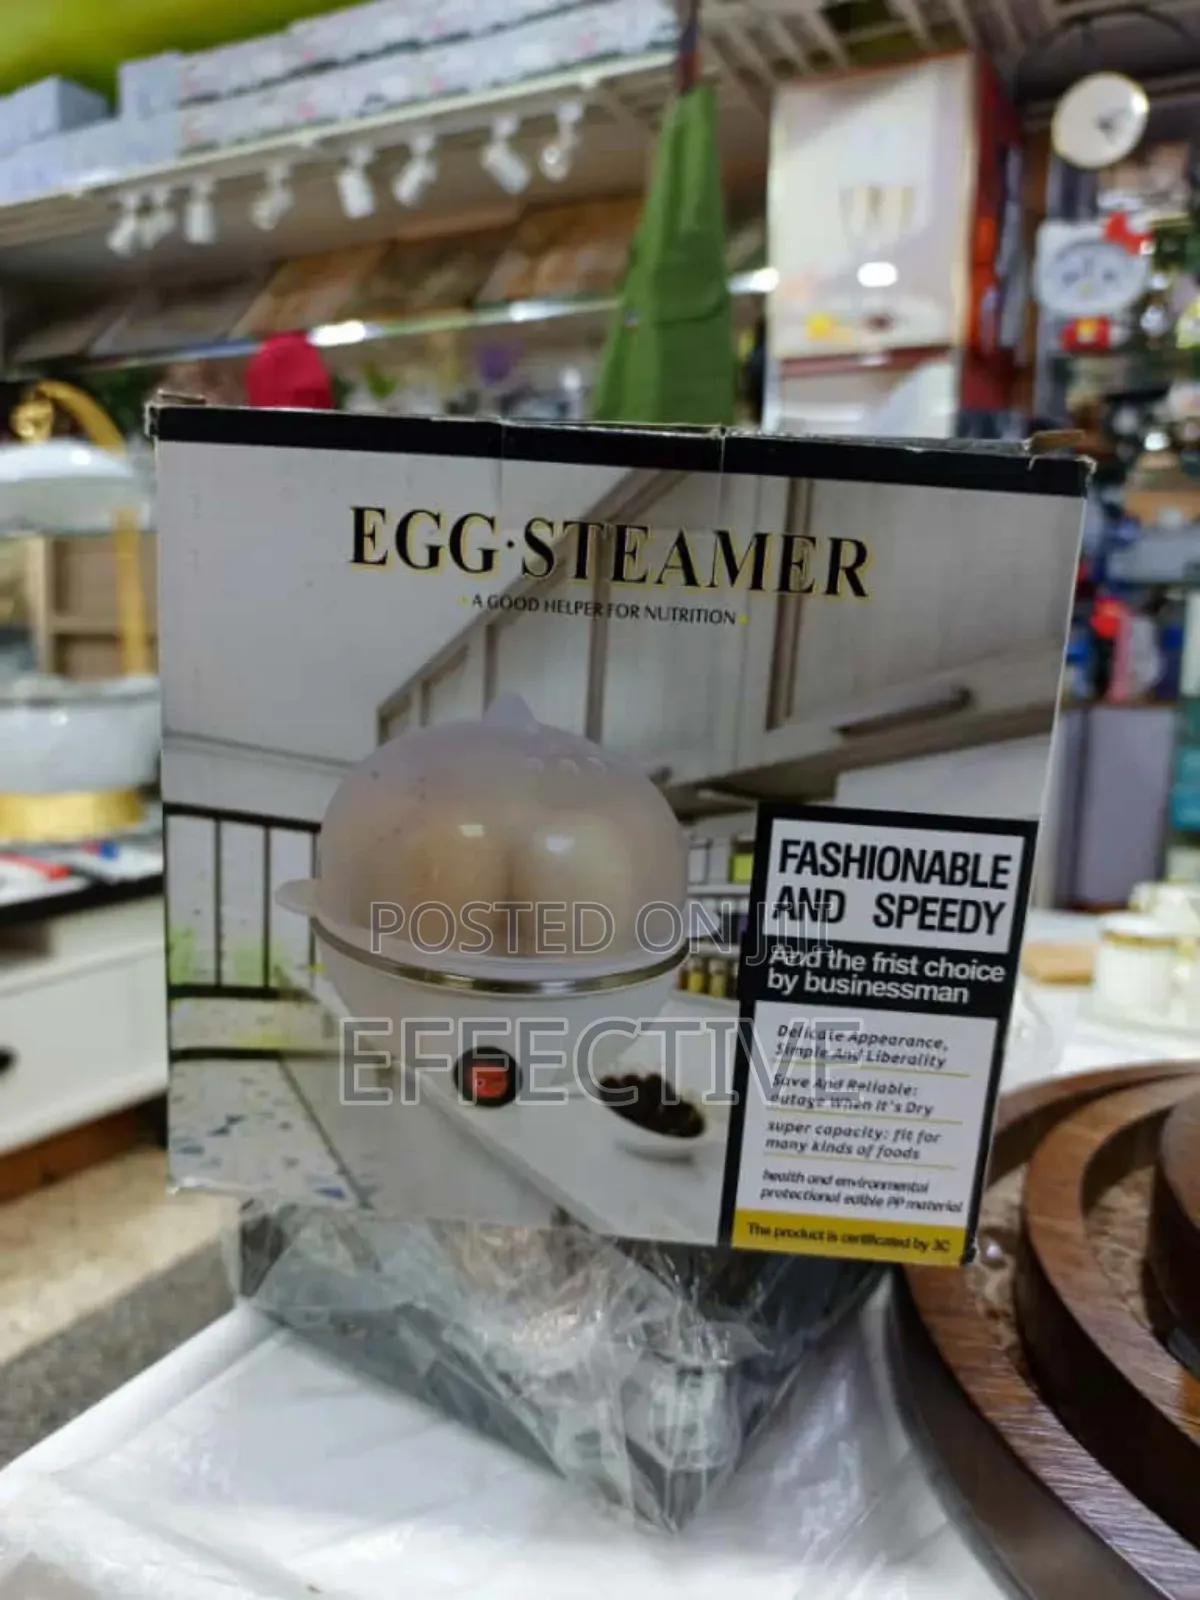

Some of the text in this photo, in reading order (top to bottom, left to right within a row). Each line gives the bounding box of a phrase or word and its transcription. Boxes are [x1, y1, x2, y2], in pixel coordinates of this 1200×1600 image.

[472, 594, 736, 624] A GOOD HELPER FOR NUTRITION
[779, 838, 1012, 890] FASHIONABLE
[772, 885, 1007, 935] AND SPEEDY
[769, 945, 1006, 982] And the frist choice
[767, 967, 969, 1004] by businessman
[866, 1049, 947, 1070] Liberality
[905, 1102, 934, 1118] Dry
[767, 1119, 812, 1136] super
[814, 1122, 891, 1142] capacity:
[915, 1128, 944, 1145] for
[765, 1136, 921, 1161] many kinds of foods
[762, 1168, 805, 1184] health
[807, 1172, 834, 1186] and
[747, 1221, 771, 1236] The
[774, 1225, 825, 1242] product
[913, 1236, 929, 1252] by
